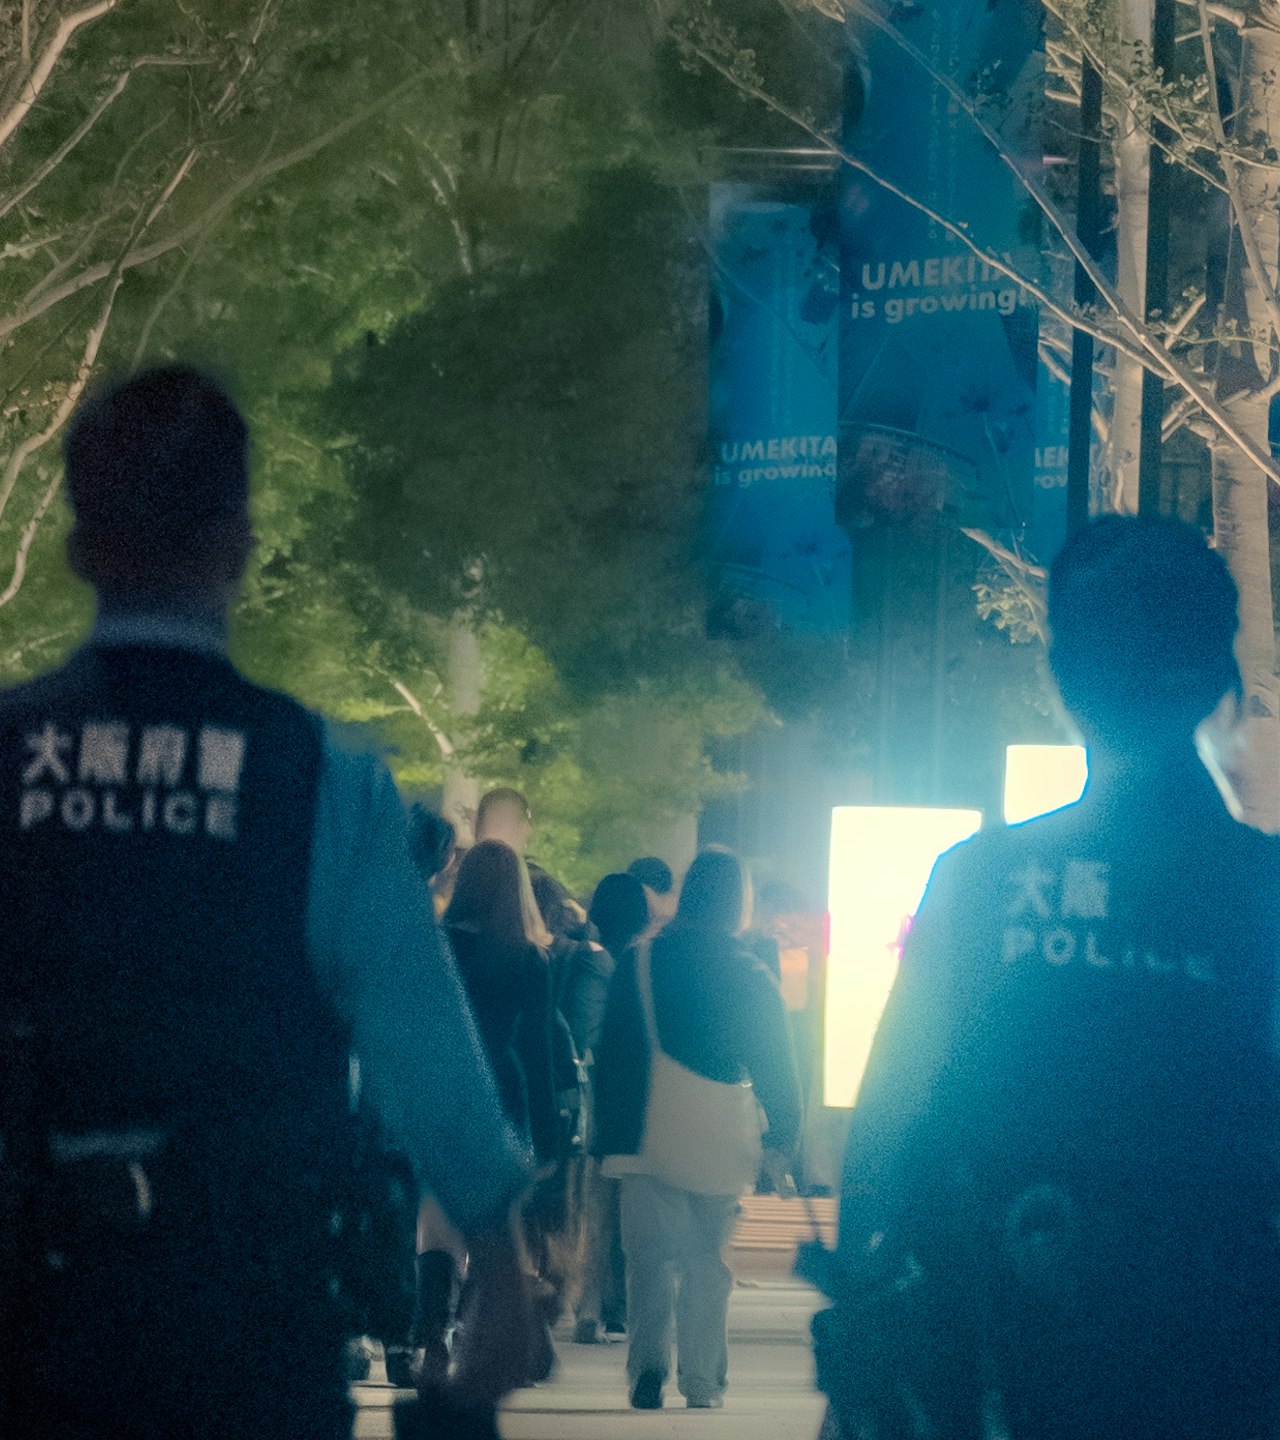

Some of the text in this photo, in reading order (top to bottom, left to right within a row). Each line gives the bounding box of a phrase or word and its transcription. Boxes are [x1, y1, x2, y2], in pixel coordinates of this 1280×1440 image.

[851, 291, 876, 319] is
[721, 435, 837, 464] UMEKITA
[714, 465, 731, 486] is
[19, 788, 239, 841] POLICE
